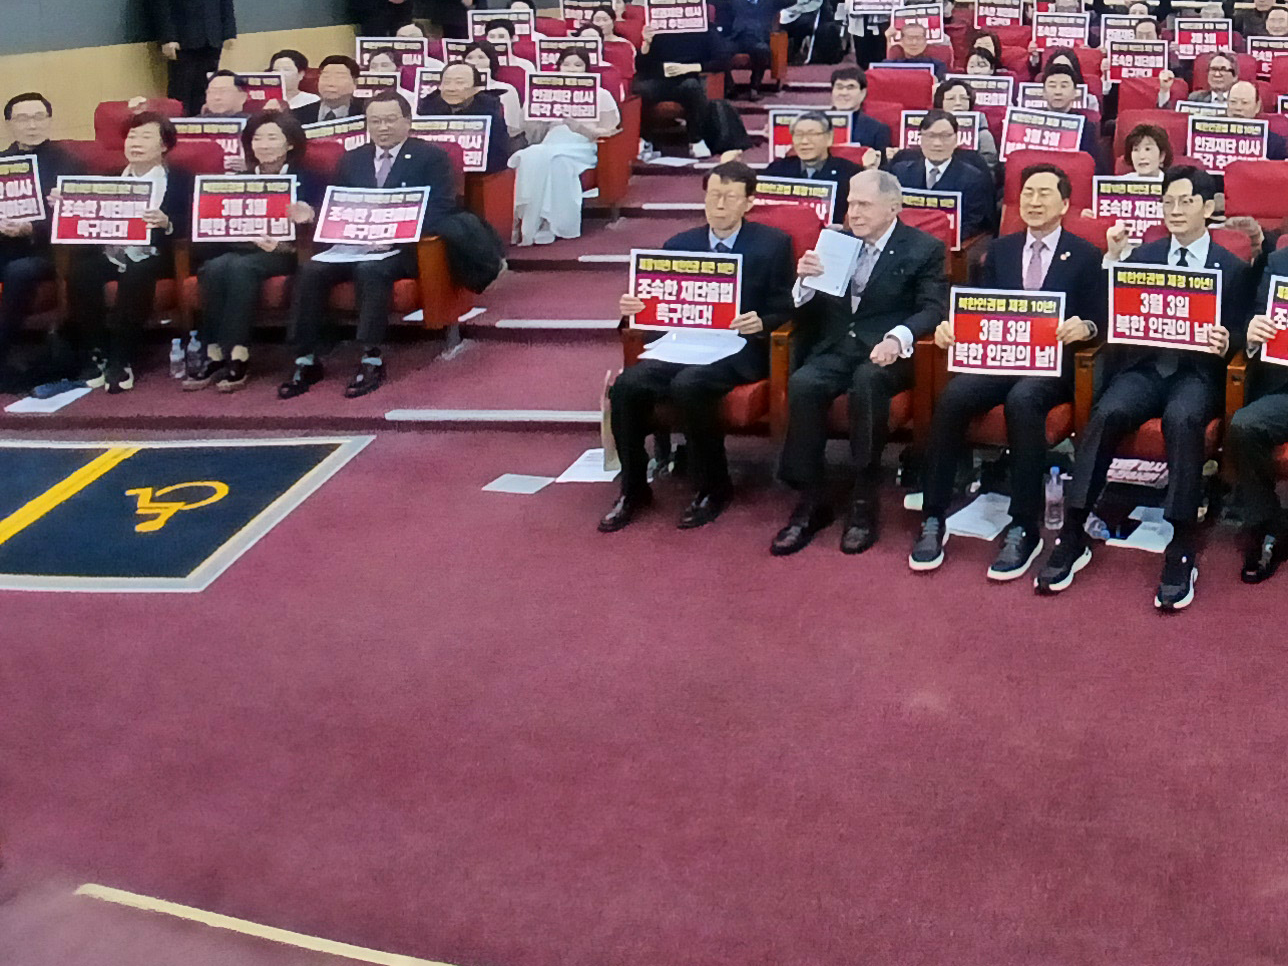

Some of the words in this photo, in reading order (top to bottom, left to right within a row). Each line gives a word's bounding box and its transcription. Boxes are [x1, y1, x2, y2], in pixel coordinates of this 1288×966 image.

[636, 278, 677, 300] 조속한
[1167, 274, 1186, 288] 제정
[1188, 276, 1213, 290] 10년!
[1008, 299, 1027, 312] 제정
[1030, 300, 1056, 313] 10년!
[1140, 292, 1163, 314] 3월
[1166, 295, 1189, 317] 3일
[979, 319, 1003, 341] 3월
[1006, 320, 1030, 342] 3일
[1116, 314, 1143, 336] 북한
[1148, 317, 1190, 340] 인권의
[954, 342, 983, 364] 북한
[986, 344, 1030, 366] 인권의
[1035, 345, 1054, 367] 날!
